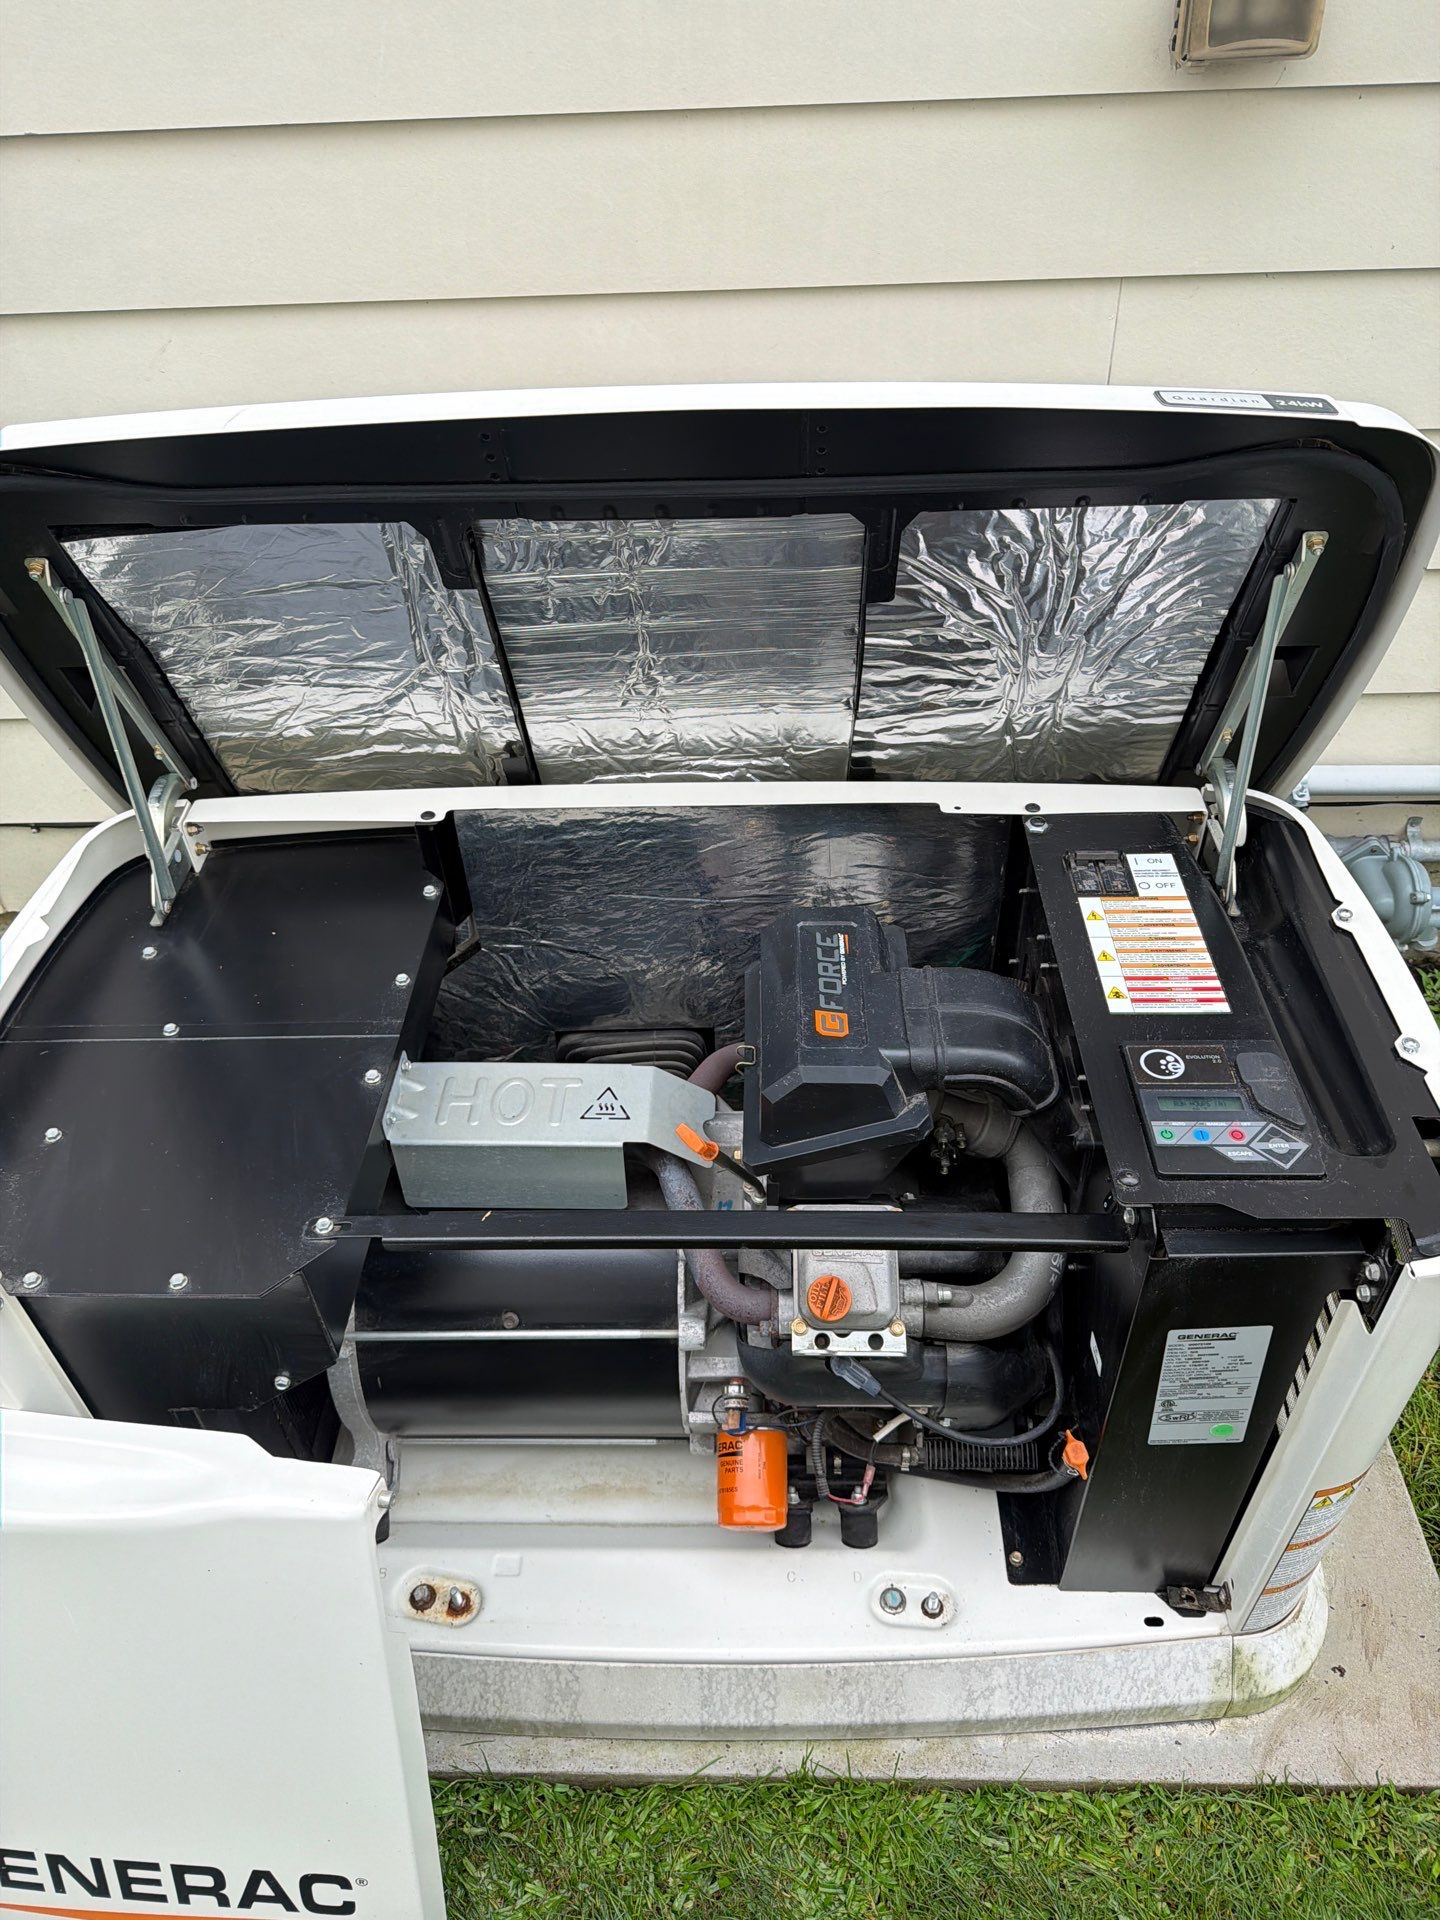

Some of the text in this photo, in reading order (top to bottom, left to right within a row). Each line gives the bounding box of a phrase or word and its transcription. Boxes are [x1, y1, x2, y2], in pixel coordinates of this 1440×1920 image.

[1172, 395, 1324, 408] Guardian 24kW
[816, 932, 844, 1010] FORCE
[435, 1076, 584, 1127] HOT
[810, 1282, 821, 1303] OIL
[1177, 1332, 1237, 1340] GENERAC
[720, 1459, 744, 1468] GENUINE
[724, 1466, 744, 1474] PARTS
